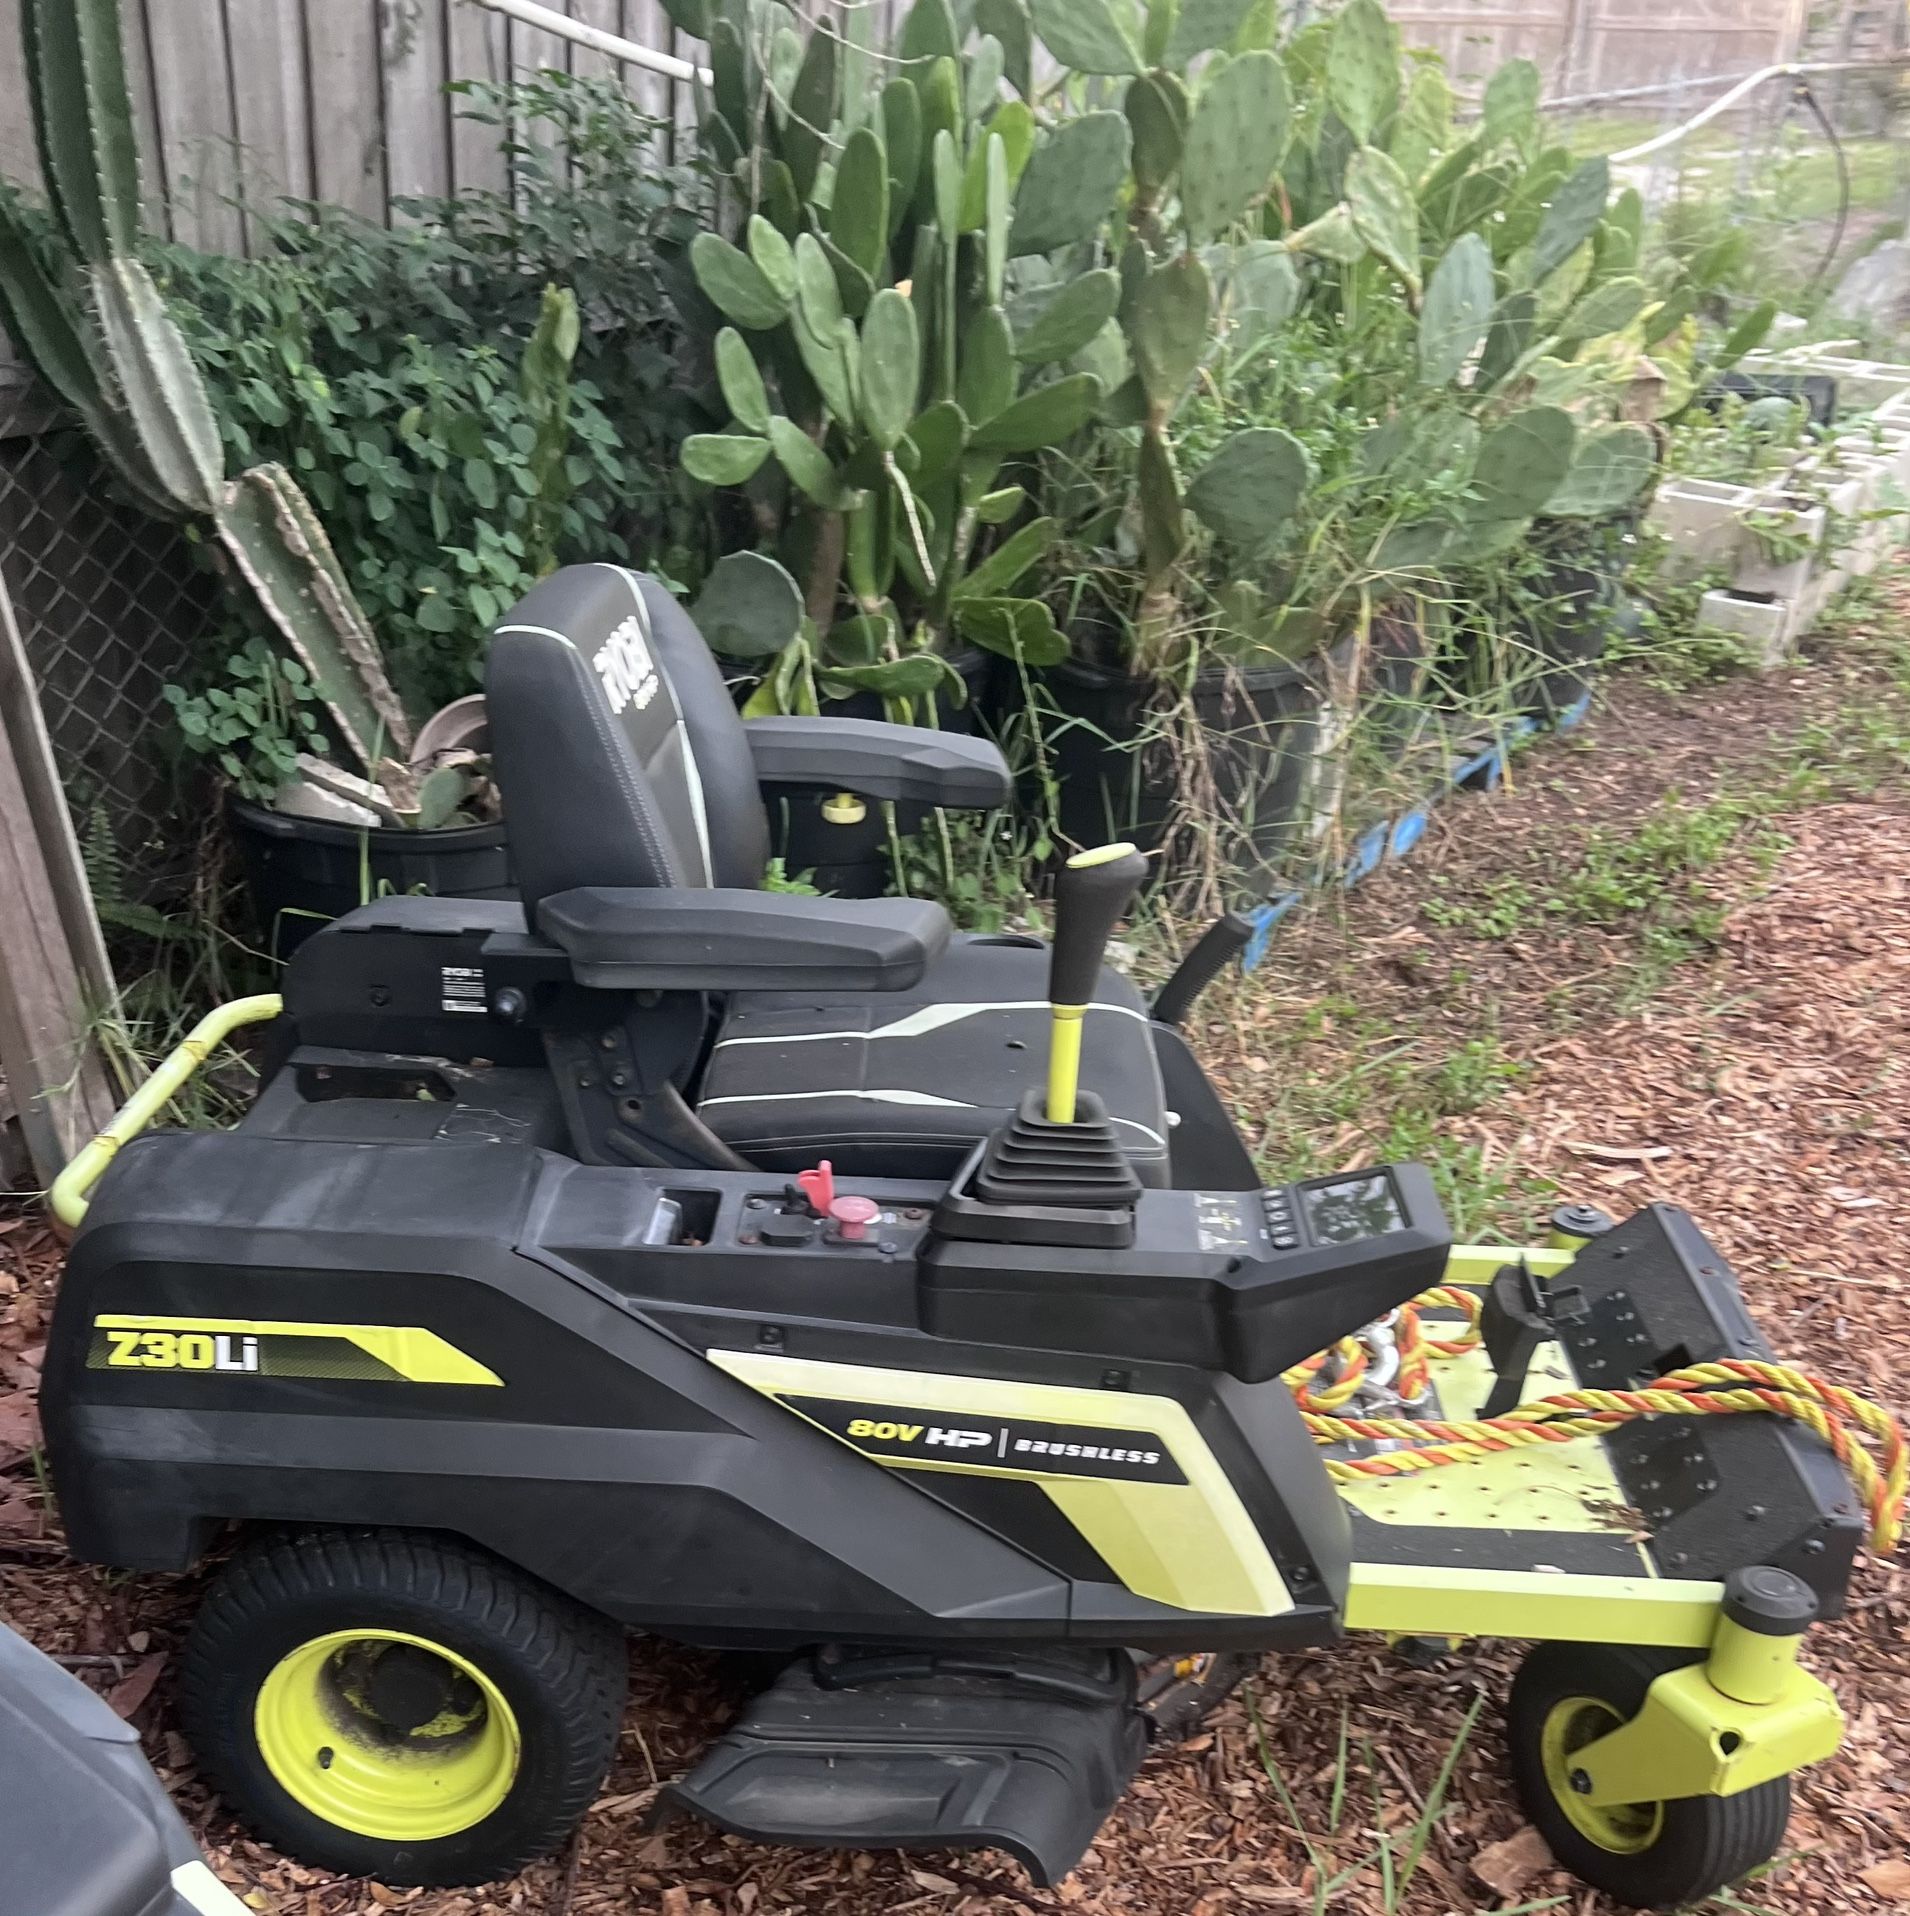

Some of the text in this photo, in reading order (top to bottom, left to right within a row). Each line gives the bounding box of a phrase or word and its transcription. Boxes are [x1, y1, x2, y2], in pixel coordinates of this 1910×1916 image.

[107, 1331, 258, 1371] Z30Li
[847, 1419, 1161, 1465] 80V HP BRUSHLESS
